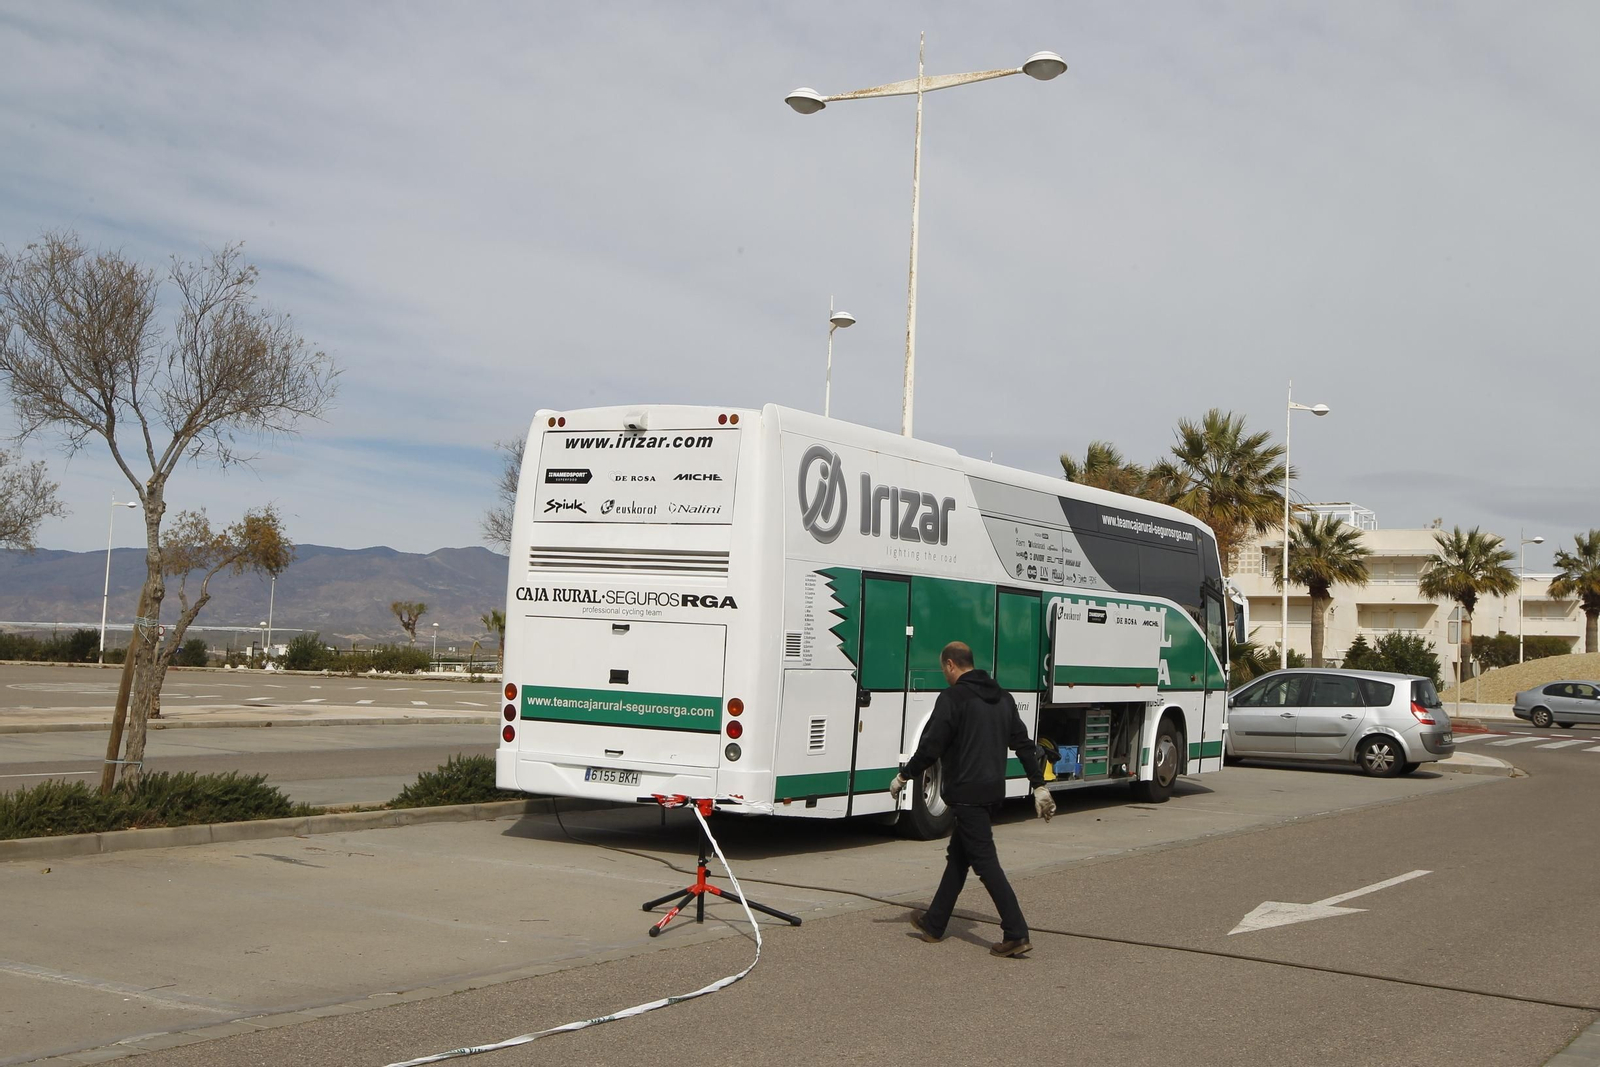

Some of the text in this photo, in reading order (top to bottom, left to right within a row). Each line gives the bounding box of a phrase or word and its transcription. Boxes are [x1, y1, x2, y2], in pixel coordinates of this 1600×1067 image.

[565, 434, 713, 449] www.irizar.com
[673, 473, 723, 481] MICHE
[544, 498, 587, 514] Spiuk
[678, 502, 722, 514] Nalini
[859, 471, 956, 546] Irizar
[1101, 514, 1194, 542] www.teamcajarural-segurosrga.com
[886, 546, 957, 563] lighting the road
[516, 587, 738, 609] CAJA RURAL SEGUROS RGA
[582, 606, 620, 615] professional
[622, 607, 644, 617] cycling
[527, 696, 714, 718] www.teamcajarural-segurosrga.com
[591, 769, 639, 784] 6155 BKH
